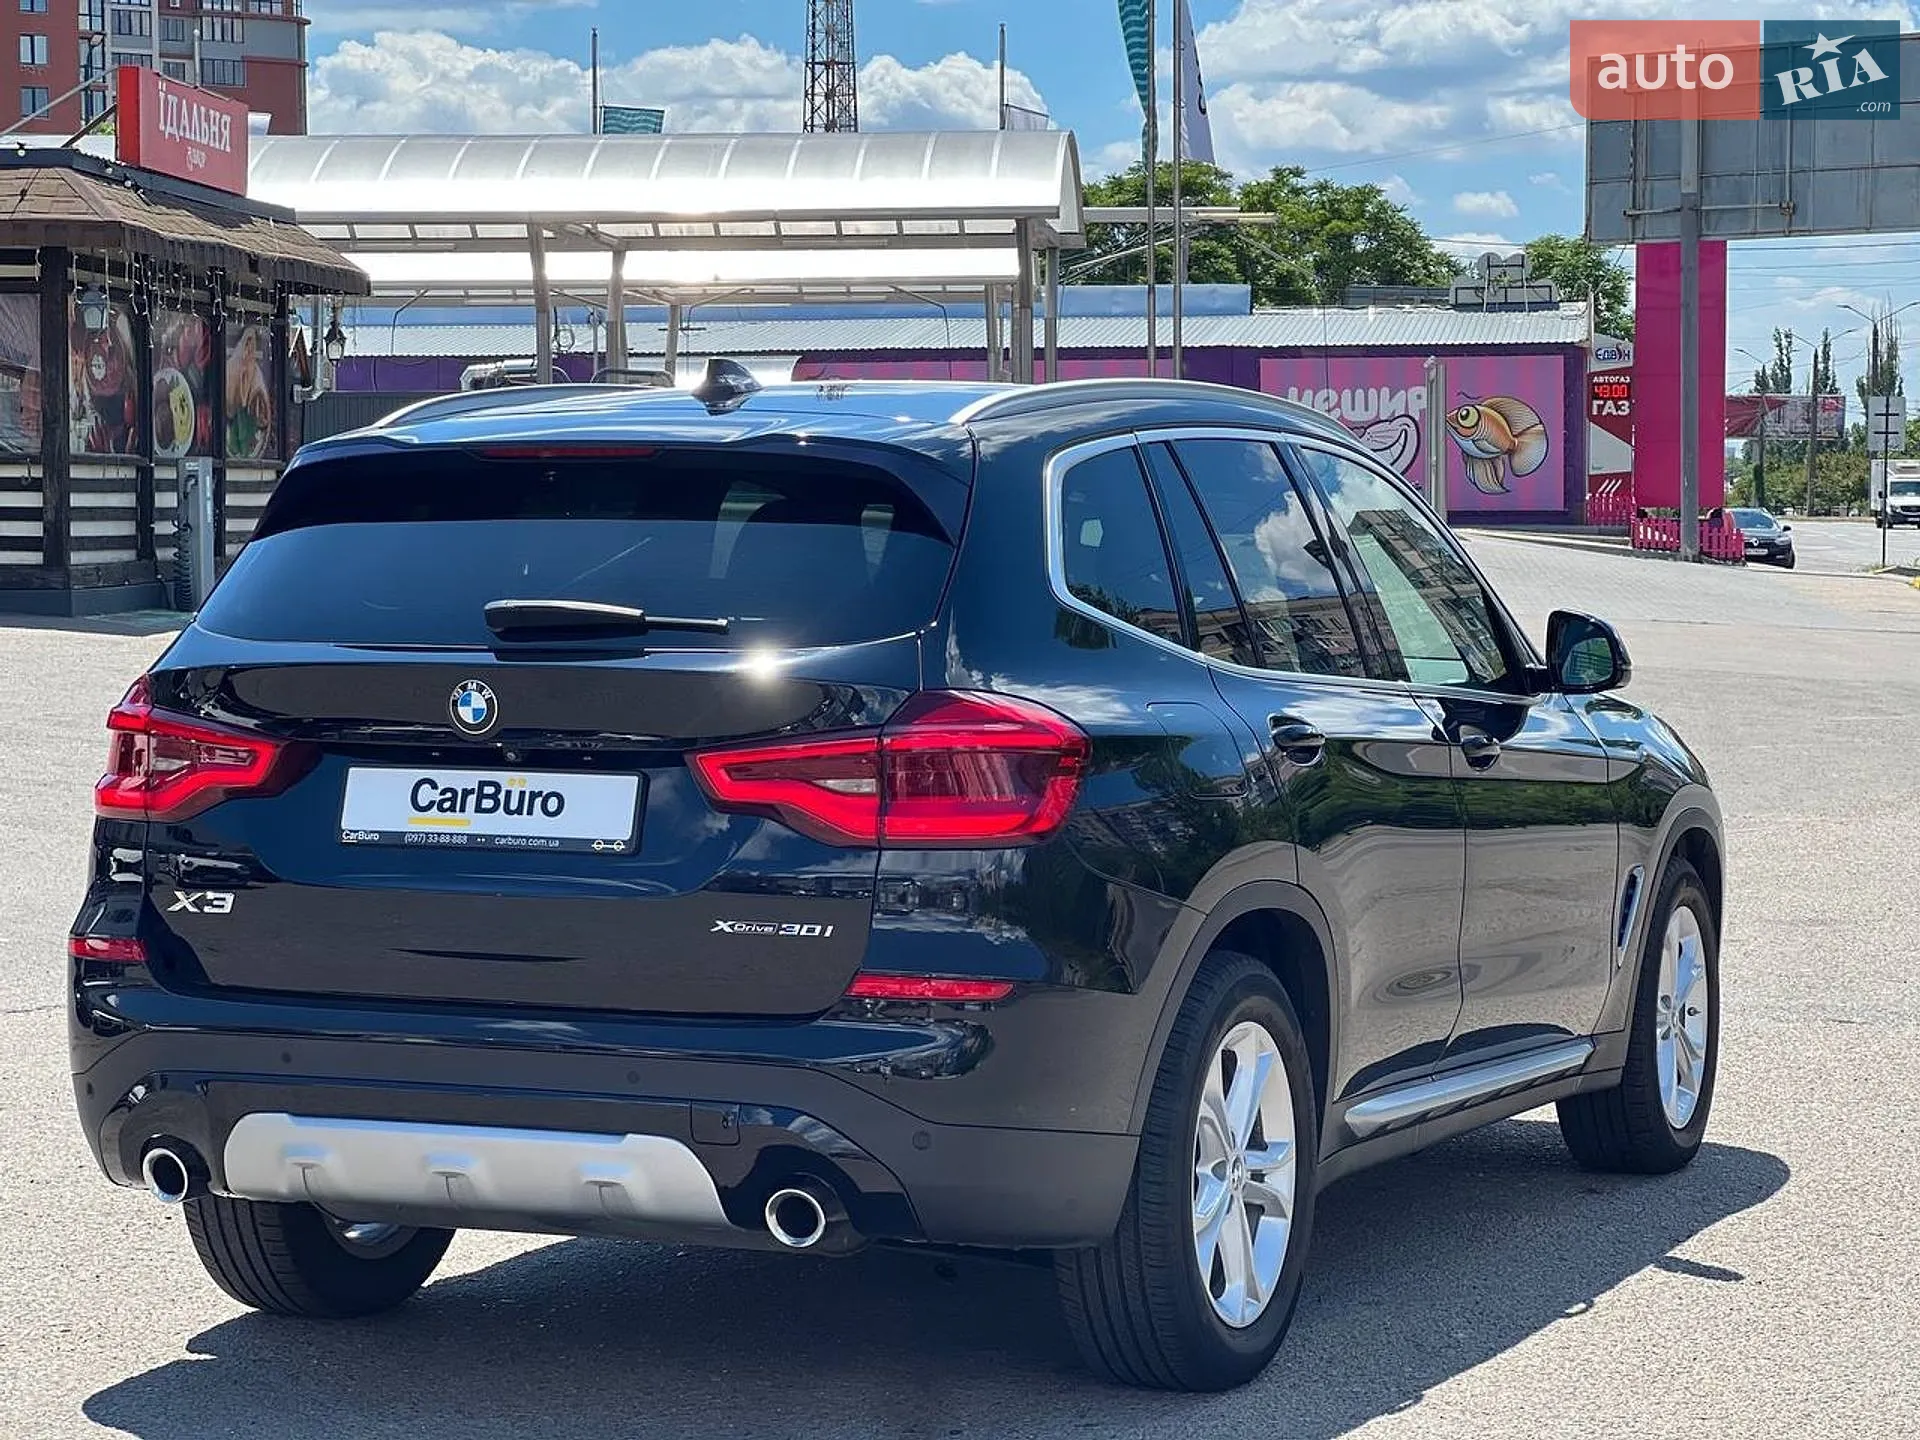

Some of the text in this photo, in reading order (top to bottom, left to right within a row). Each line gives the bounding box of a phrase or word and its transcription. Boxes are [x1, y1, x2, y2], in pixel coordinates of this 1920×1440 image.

[158, 80, 231, 152] ЇДАЛЬНЯ
[1595, 384, 1628, 398] 43.00
[1592, 400, 1631, 416] ГАЗ
[452, 682, 492, 700] BMW
[410, 777, 566, 818] CarBüro
[404, 833, 426, 844] (097)
[166, 890, 235, 913] X3
